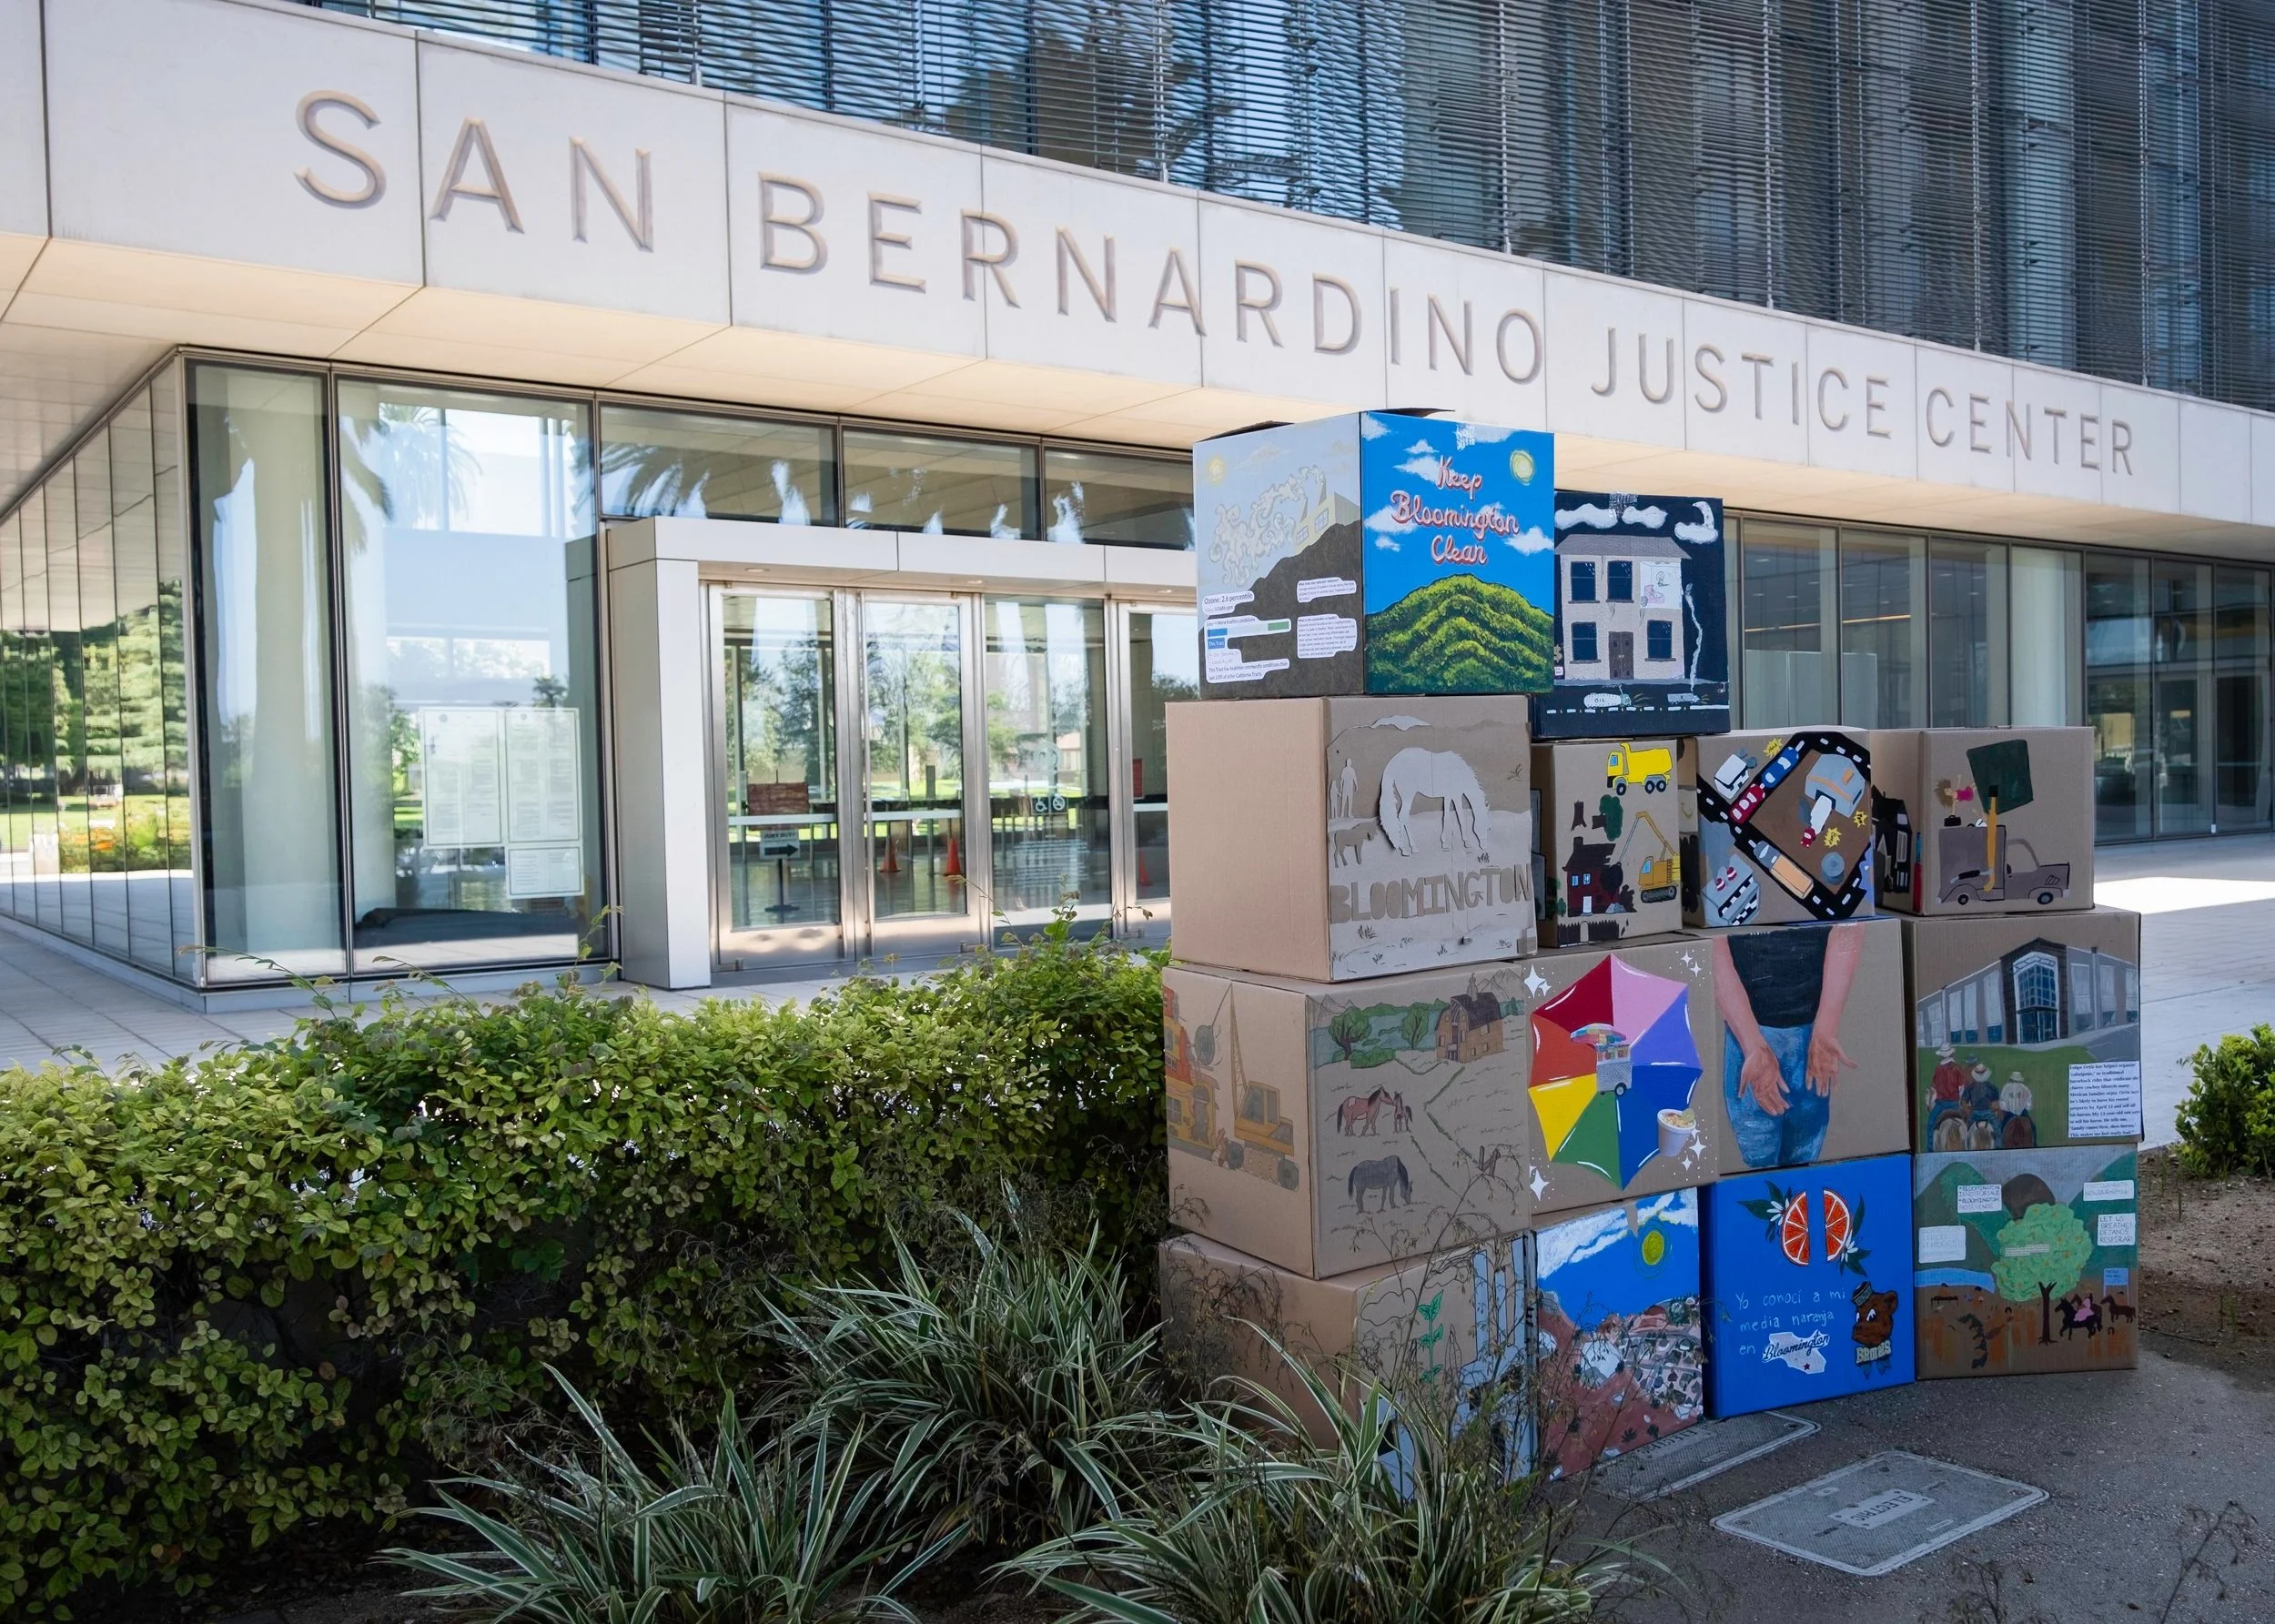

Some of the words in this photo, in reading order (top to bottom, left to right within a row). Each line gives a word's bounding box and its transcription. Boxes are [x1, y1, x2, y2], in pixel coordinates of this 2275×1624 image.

[293, 89, 653, 254] SAN
[757, 170, 1544, 386] BERNARDINO
[1591, 326, 1892, 439] JUSTICE
[1926, 386, 2134, 476] CENTER
[1437, 454, 1483, 501] Keep
[1390, 489, 1520, 540] Bloomington
[1431, 535, 1488, 565] Clean
[1229, 593, 1253, 601] percentile
[1330, 862, 1533, 924] BLOOMINGTON
[1735, 1292, 1749, 1310] Yo
[1763, 1288, 1802, 1306] conocí
[1813, 1291, 1820, 1303] a
[1830, 1287, 1845, 1300] mi
[1740, 1315, 1780, 1332] media
[1792, 1310, 1835, 1327] naranja
[1739, 1344, 1756, 1356] en
[1764, 1329, 1830, 1362] Bloomington
[1850, 1495, 1914, 1522] ELECTRIC
